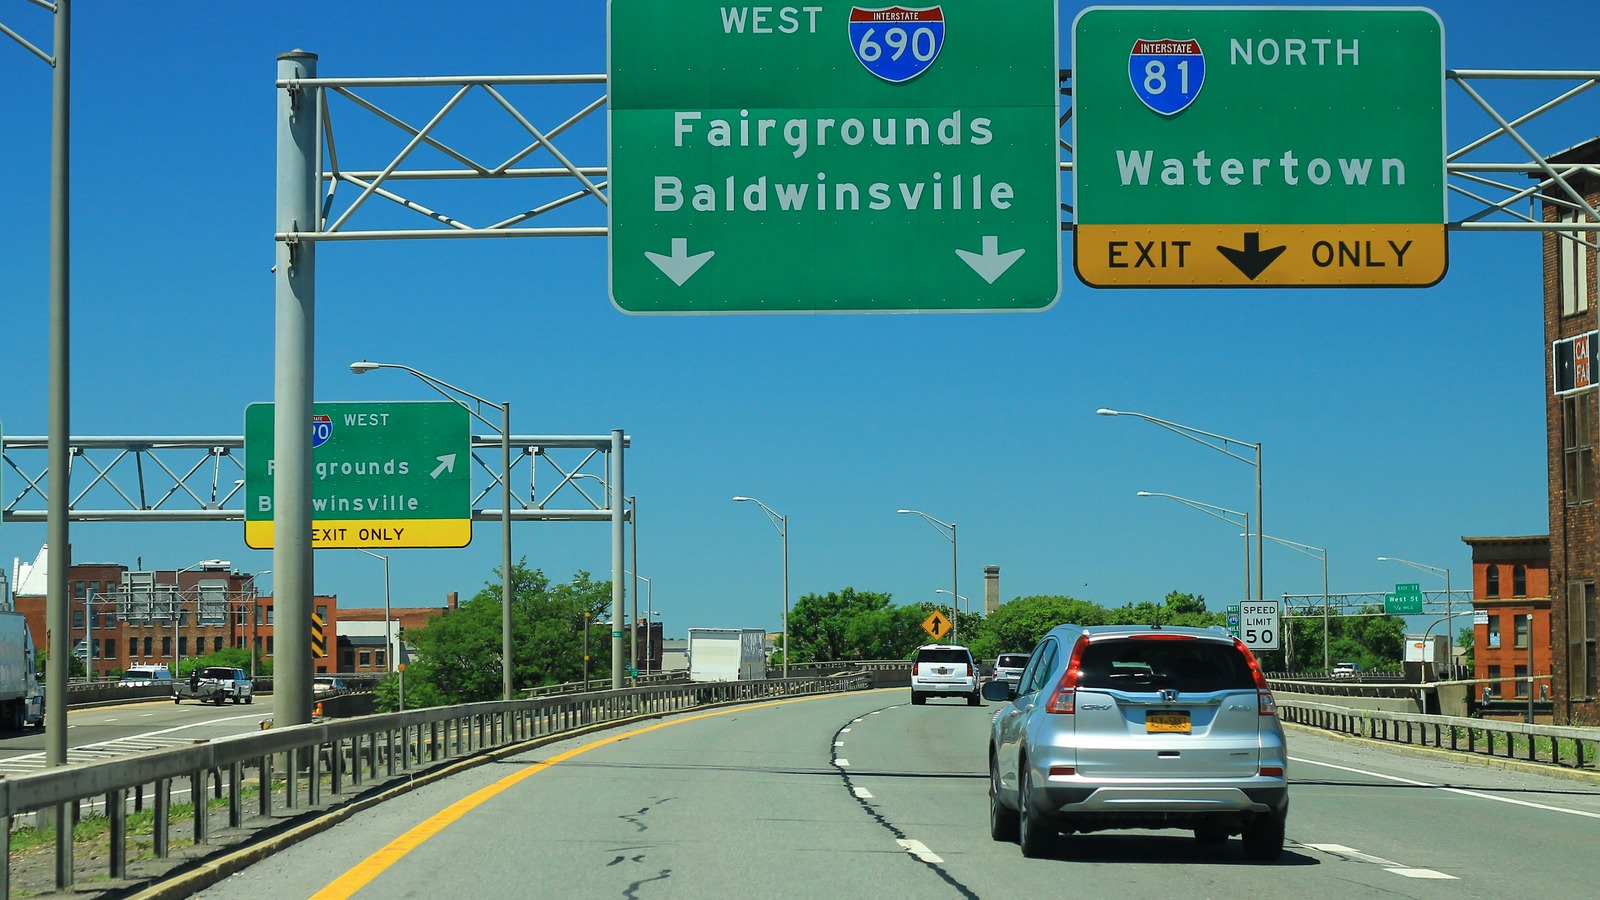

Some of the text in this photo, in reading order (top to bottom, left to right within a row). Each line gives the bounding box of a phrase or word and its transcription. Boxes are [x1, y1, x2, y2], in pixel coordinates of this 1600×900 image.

[720, 6, 823, 35] WEST
[873, 11, 919, 21] INTERSTATE
[858, 27, 936, 62] 690
[1140, 43, 1192, 54] INTERSTATE
[1230, 38, 1360, 66] NORTH
[1143, 60, 1189, 95] 81
[674, 109, 993, 158] Fairgrounds
[1116, 149, 1406, 186] Watertown
[653, 171, 1015, 212] Baldwinsville
[1108, 240, 1414, 268] EXIT ONLY
[344, 413, 390, 427] WEST
[267, 459, 410, 480] Fgrounds
[258, 495, 419, 512] Bwinsville
[312, 528, 405, 541] EXIT ONLY
[1243, 606, 1276, 614] SPEED
[1246, 618, 1272, 626] LIMIT
[1246, 629, 1273, 644] 50
